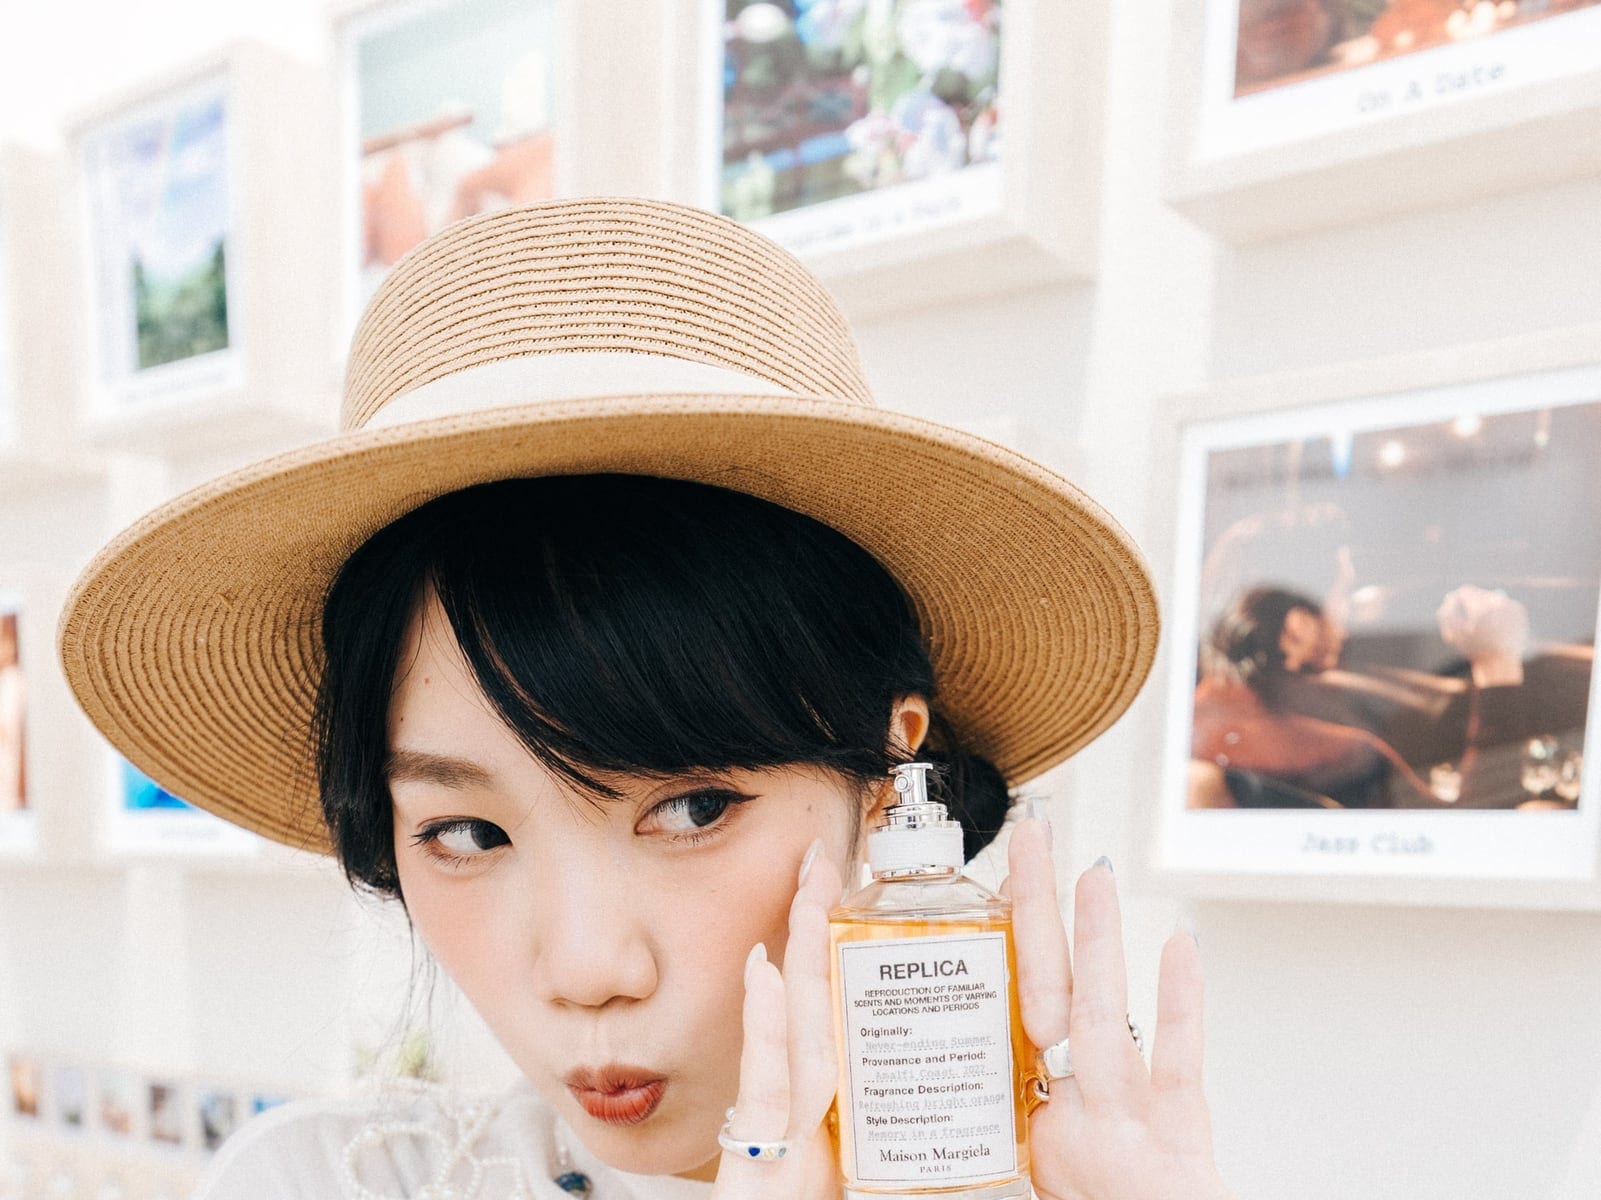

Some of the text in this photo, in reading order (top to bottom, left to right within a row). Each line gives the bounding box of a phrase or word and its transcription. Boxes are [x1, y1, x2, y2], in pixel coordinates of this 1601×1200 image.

[880, 959, 968, 980] REPLICA
[864, 983, 985, 998] REPRODUCTION OF FAMILIAR
[854, 991, 997, 1008] SCENTS AND MOMENTS OF VARYING
[872, 1002, 980, 1016] LOCATIONS AND PERIODS
[860, 1026, 913, 1038] Originally:
[865, 1035, 992, 1051] Never-ending Summer
[862, 1051, 987, 1067] Provenance and Period:
[875, 1070, 914, 1081] Amalfi
[863, 1081, 984, 1098] Fragrance Description:
[858, 1099, 919, 1111] Refreshing
[924, 1096, 969, 1109] bright
[866, 1113, 954, 1127] Style Description:
[868, 1129, 906, 1140] Memory
[912, 1128, 925, 1138] in
[942, 1123, 1000, 1137] fragrance
[879, 1143, 991, 1163] Maison Margiela
[919, 1164, 953, 1174] PARIS
